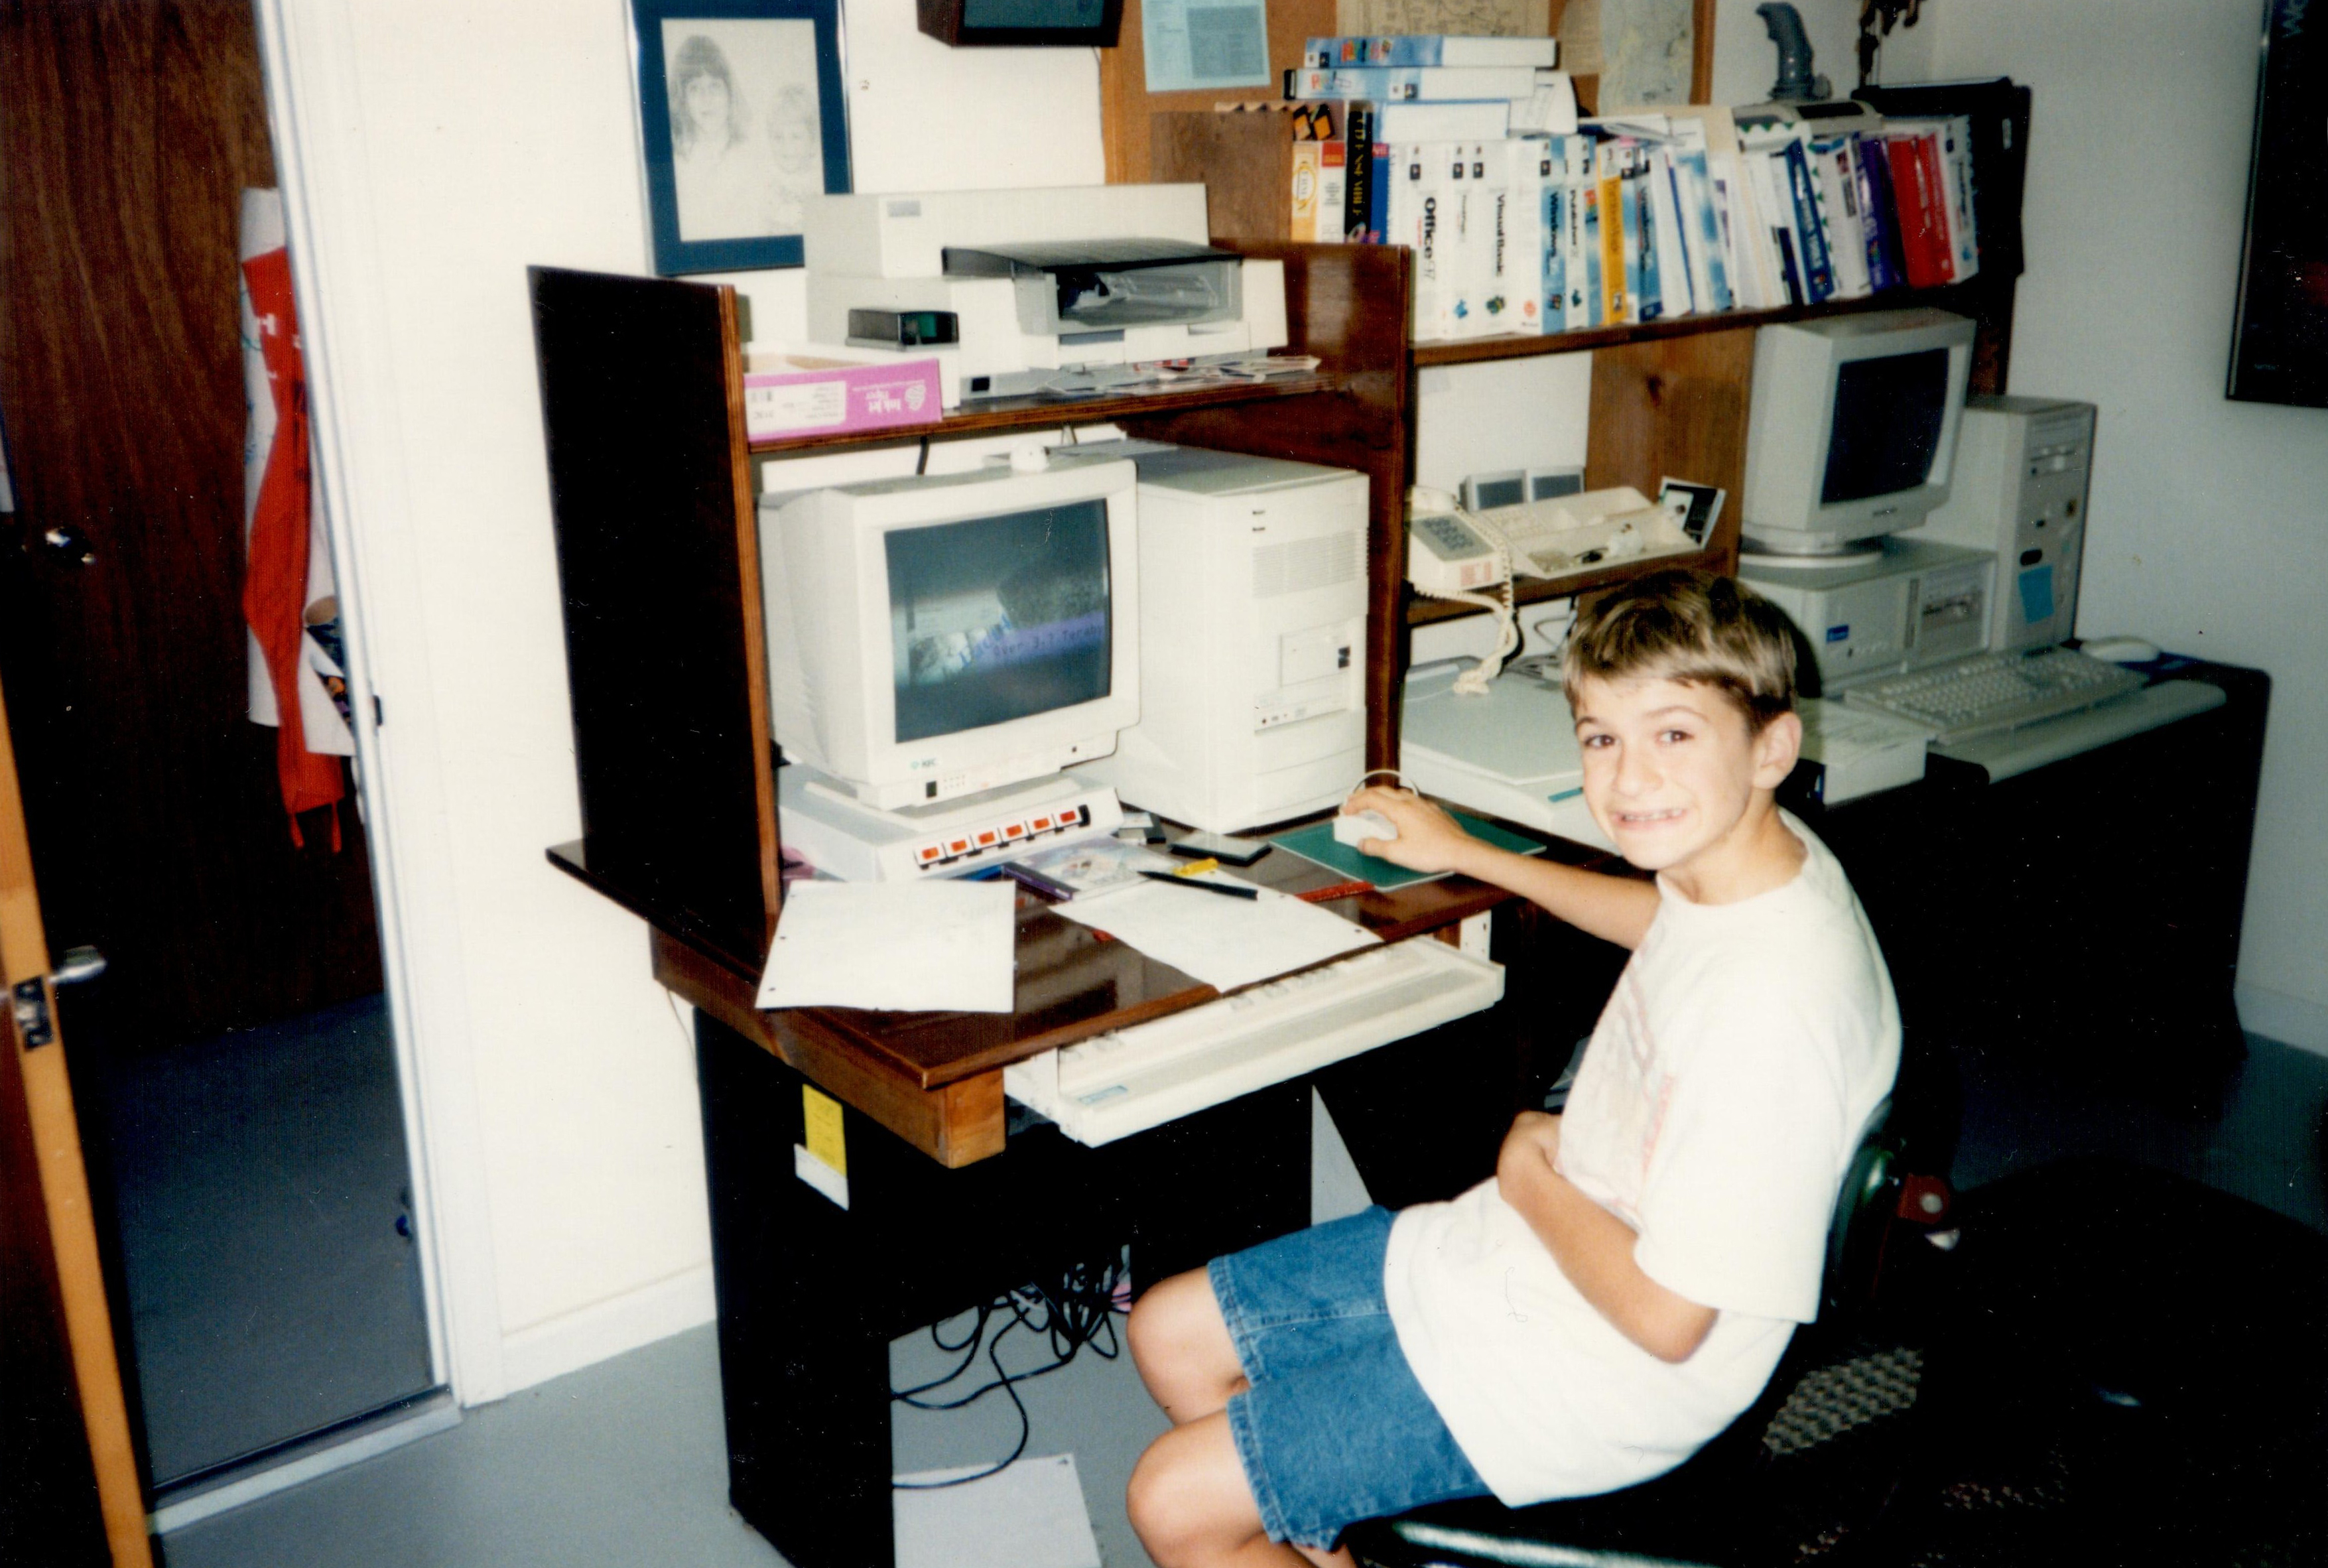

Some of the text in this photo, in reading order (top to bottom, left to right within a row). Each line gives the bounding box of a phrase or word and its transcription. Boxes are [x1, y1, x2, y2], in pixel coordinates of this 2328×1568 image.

[1424, 196, 1436, 259] Office
[1496, 194, 1506, 277] Visual Basic
[883, 398, 901, 412] Ink
